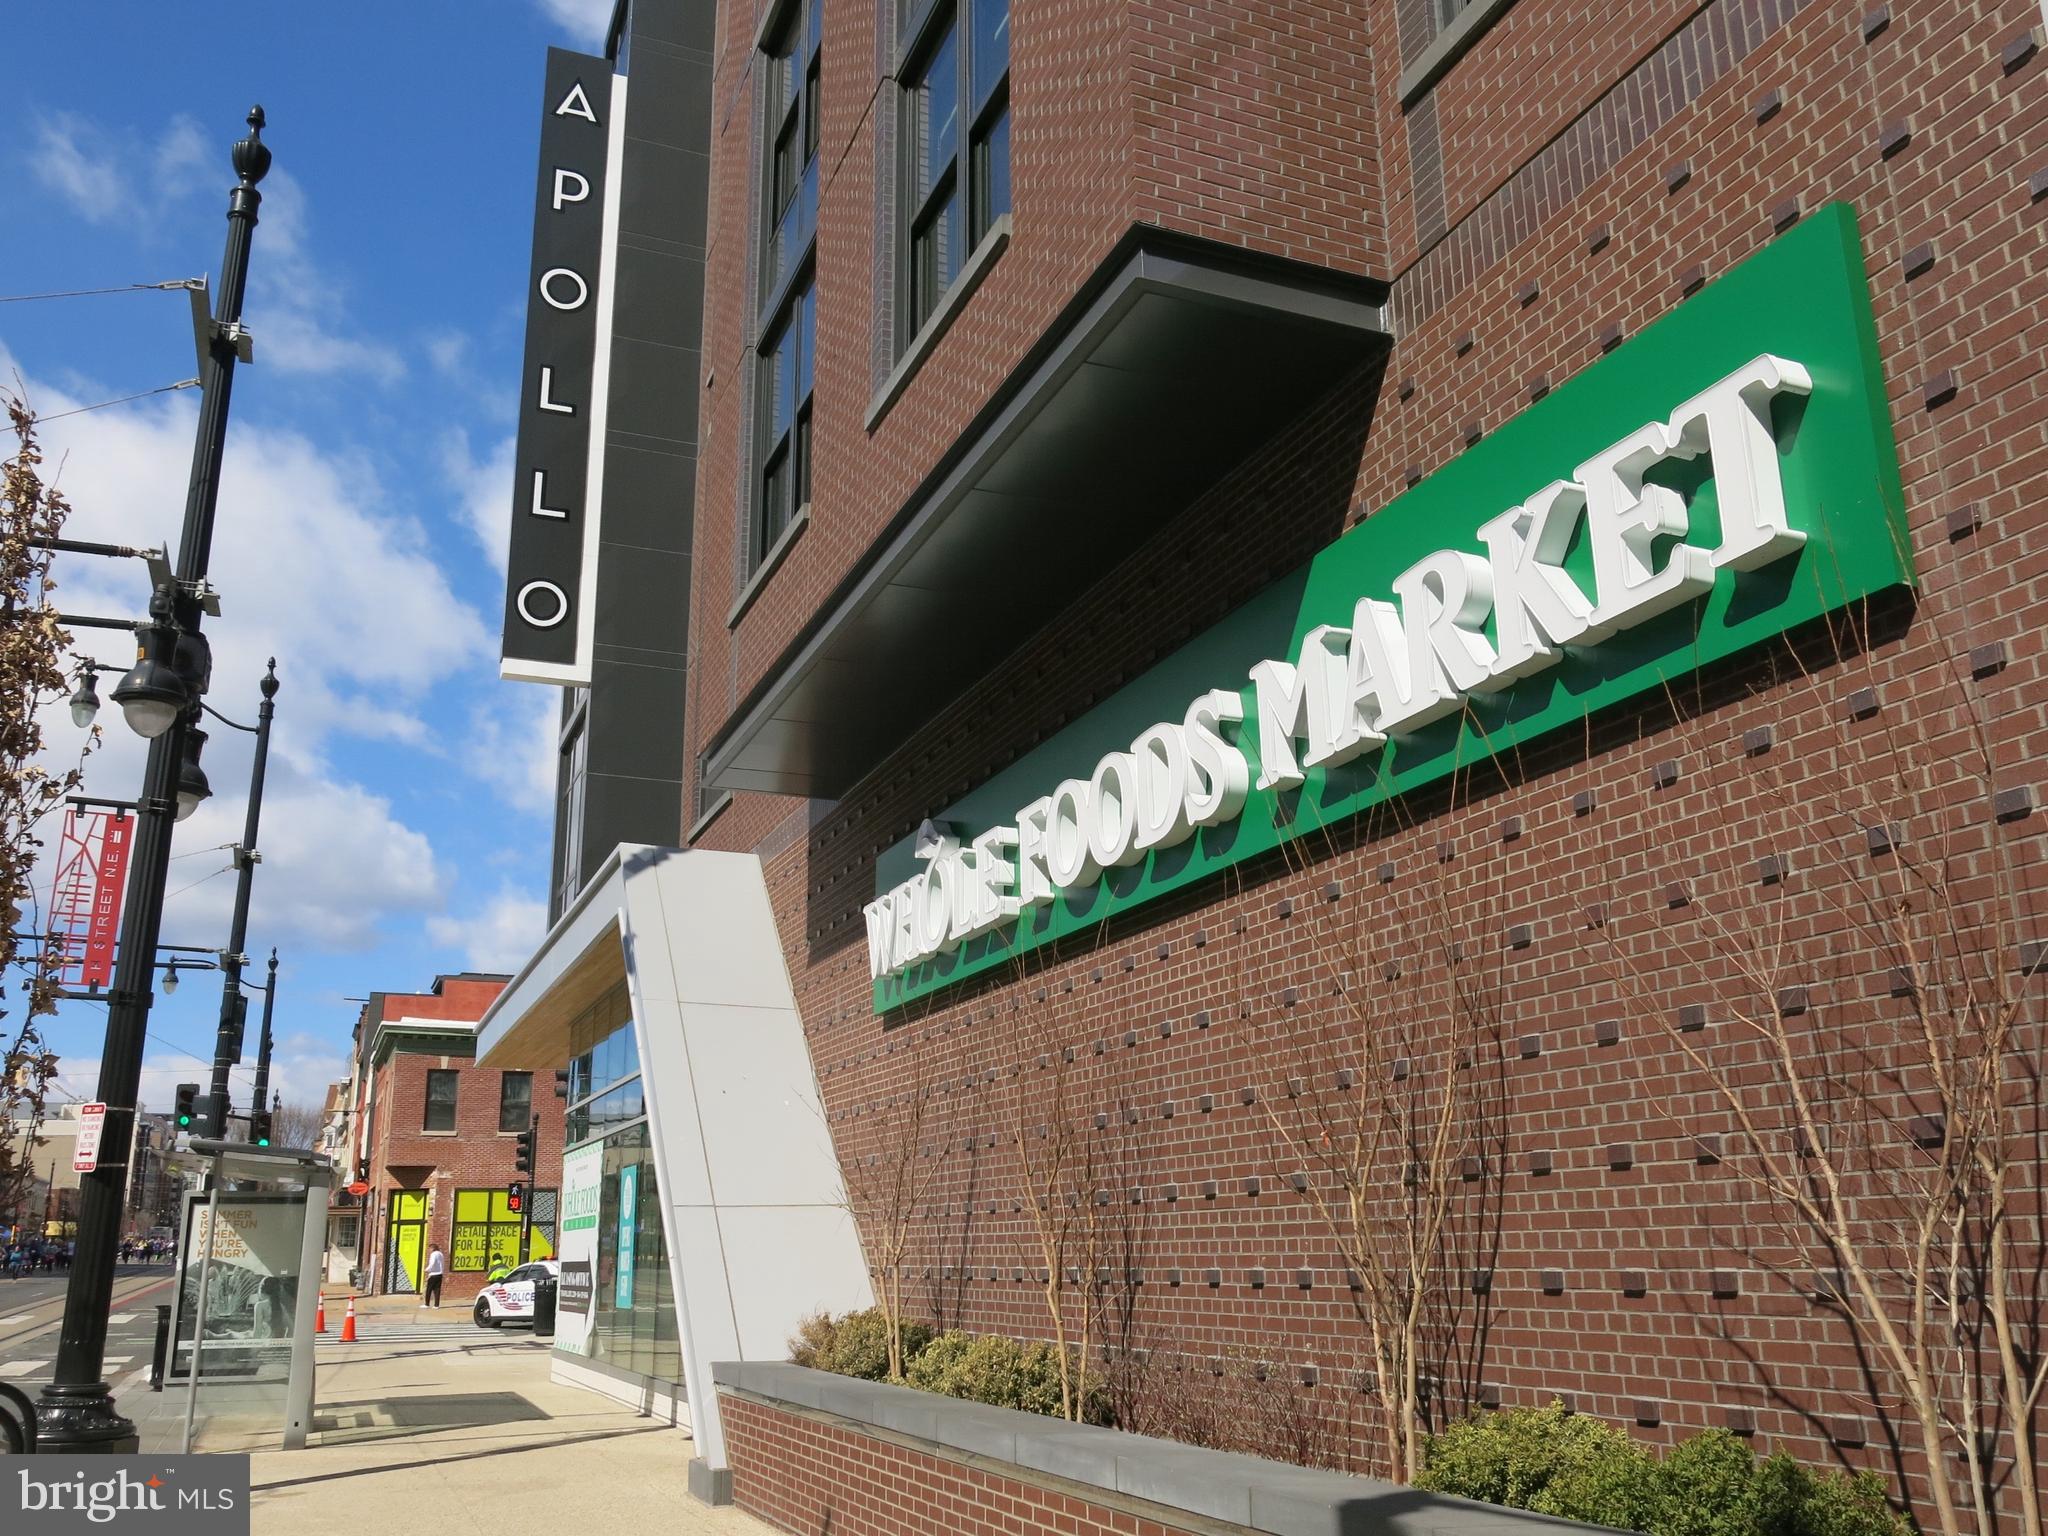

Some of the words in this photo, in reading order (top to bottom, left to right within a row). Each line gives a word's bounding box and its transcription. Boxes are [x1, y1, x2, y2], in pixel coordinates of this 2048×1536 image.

[517, 80, 597, 629] APOLLO
[863, 818, 1020, 980] WHOLE
[1016, 689, 1249, 906] FOODS
[1249, 353, 1812, 791] MARKET
[94, 885, 113, 949] STREET
[105, 850, 120, 878] N.E.
[201, 1210, 252, 1219] SMMER
[233, 1220, 257, 1229] FUN
[456, 1225, 487, 1238] RETAIL
[490, 1225, 518, 1238] SPACE
[199, 1239, 242, 1248] YU'RE
[455, 1239, 473, 1251] FOR
[506, 1292, 536, 1302] POLICE
